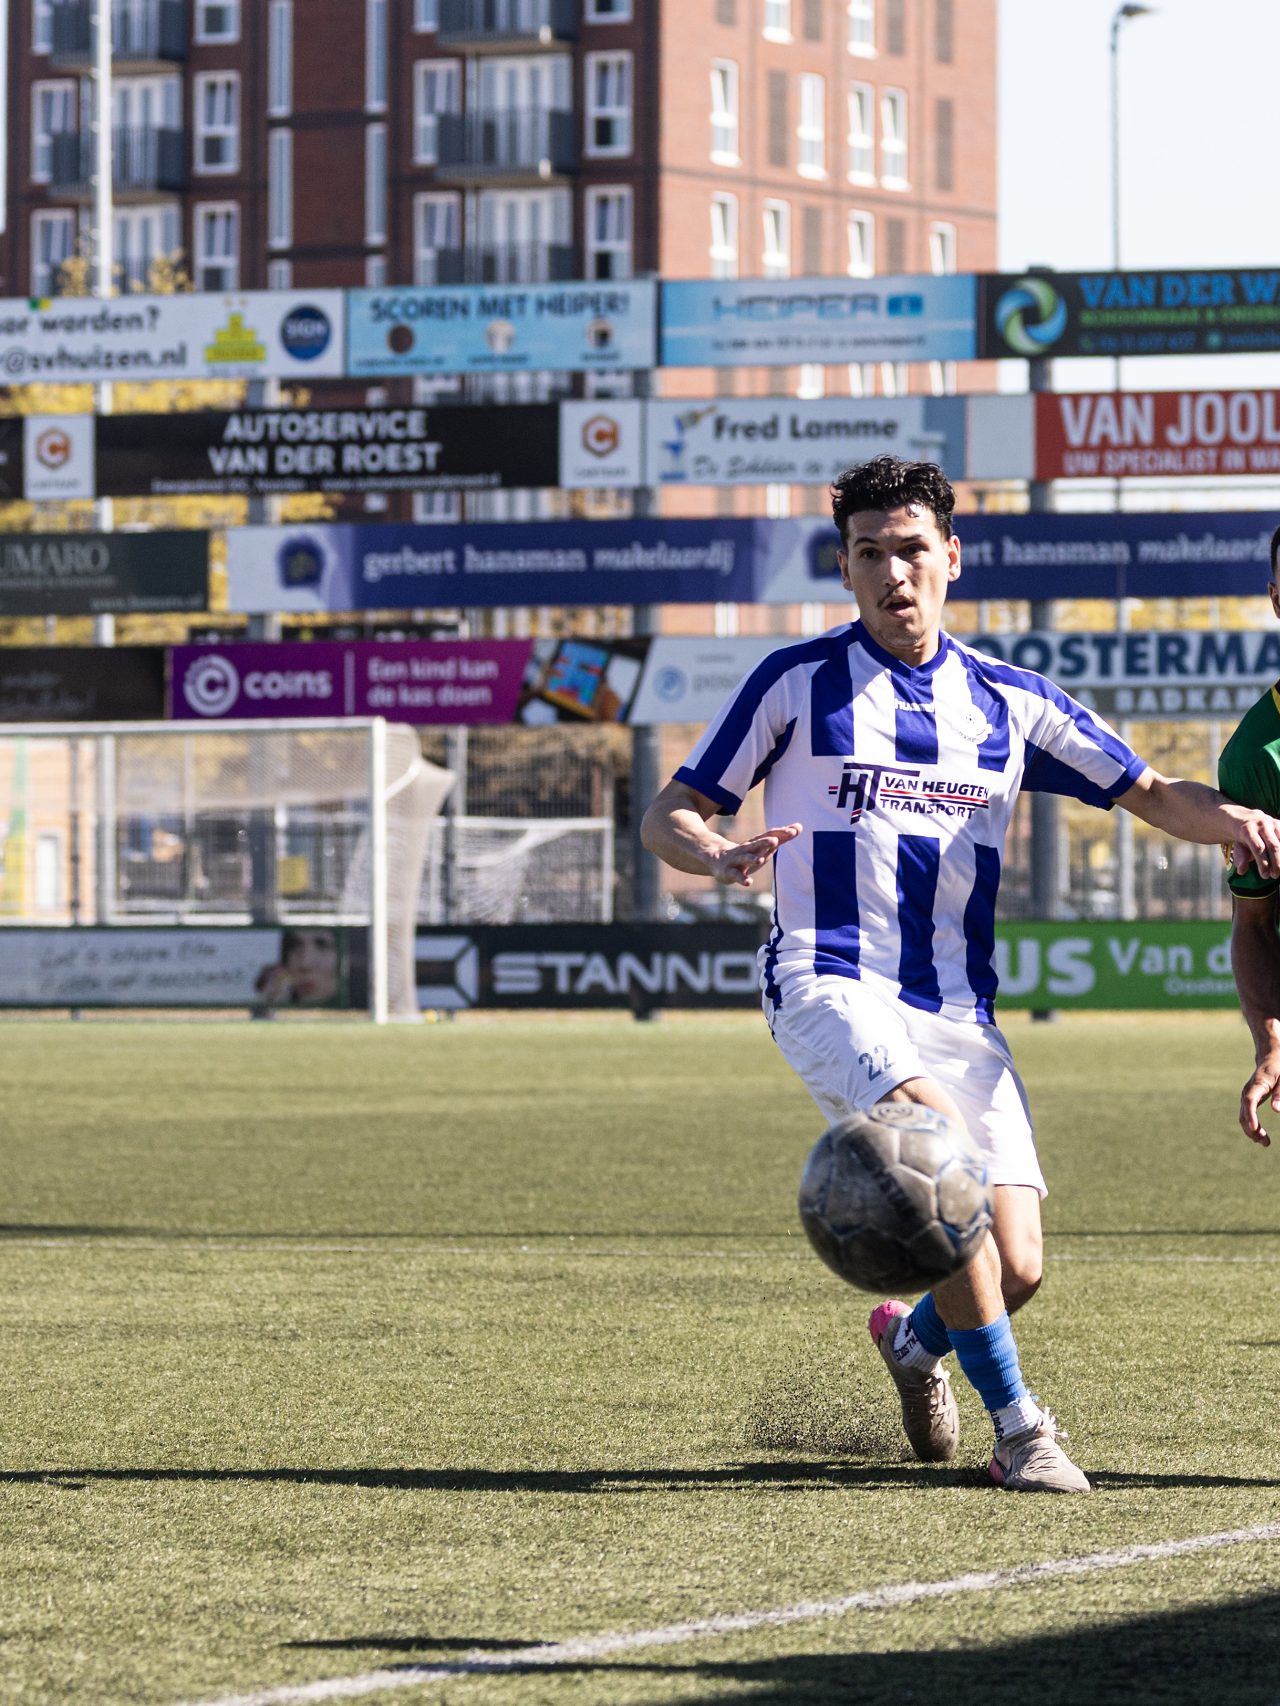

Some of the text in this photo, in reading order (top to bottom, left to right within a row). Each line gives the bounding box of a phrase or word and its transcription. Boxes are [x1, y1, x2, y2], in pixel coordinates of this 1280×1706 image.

[1079, 275, 1155, 307] VAN
[1162, 274, 1234, 306] DER
[39, 305, 160, 333] worden?
[370, 296, 468, 323] SCOREN
[476, 294, 527, 319] MET
[0, 341, 187, 375] @svhuizen.nl
[223, 410, 427, 442] AUTOSERVICE
[713, 413, 898, 440] Fred Lamme
[1061, 393, 1154, 447] VAN
[207, 442, 442, 474] VAN DER ROEST
[1063, 450, 1098, 474] UW
[1105, 448, 1218, 473] SPECIALIST
[1225, 447, 1245, 470] IN
[363, 541, 735, 582] gerbert hansman makelaardij
[1003, 537, 1130, 565] hansman
[1138, 532, 1272, 562] makelaard
[244, 670, 333, 699] coins
[367, 656, 498, 681] Een kind kan
[367, 683, 492, 707] de kas doen
[1115, 687, 1264, 713] BADKAM
[884, 776, 990, 799] VAN HEUGTEN
[879, 798, 976, 819] TRANSPORT
[994, 937, 1096, 996] US
[1108, 937, 1233, 975] Van d
[491, 952, 760, 994] STANNO
[858, 1044, 894, 1081] 22
